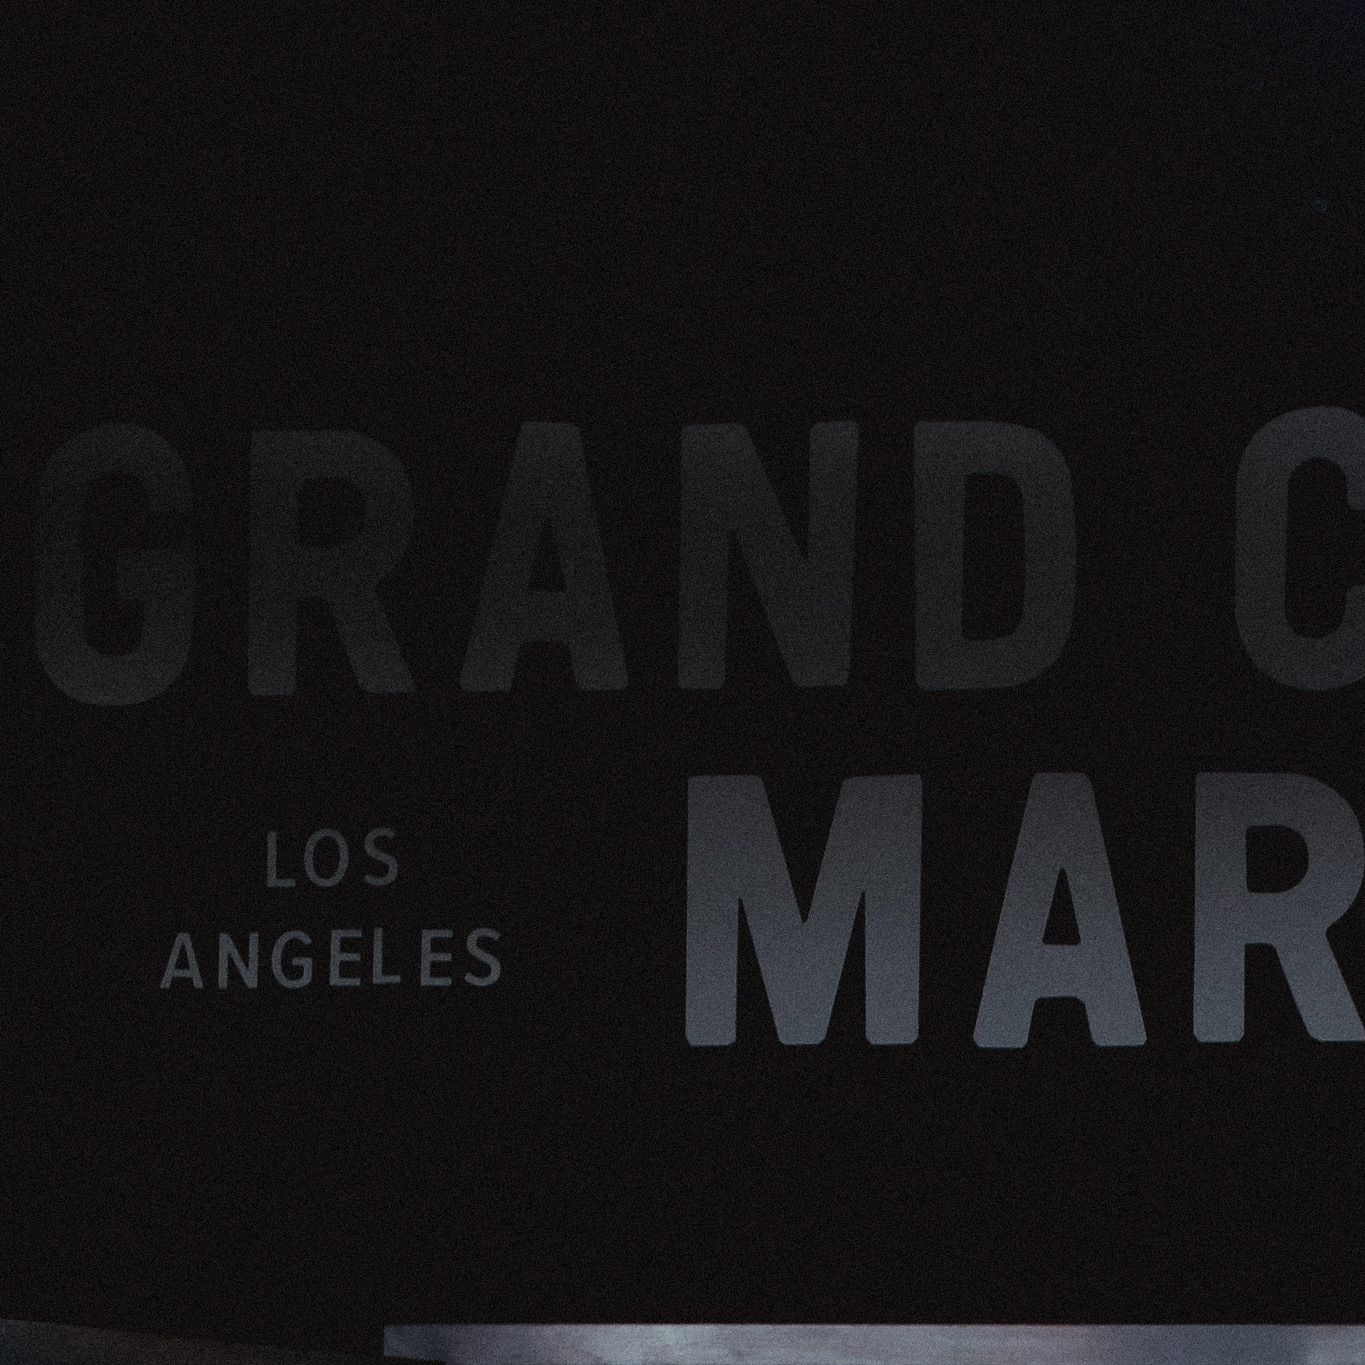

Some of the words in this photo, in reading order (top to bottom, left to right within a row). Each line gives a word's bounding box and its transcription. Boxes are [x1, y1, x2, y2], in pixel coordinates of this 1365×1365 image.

[34, 418, 1078, 708] GRAND
[262, 824, 402, 892] LOS
[159, 926, 504, 994] ANGELES
